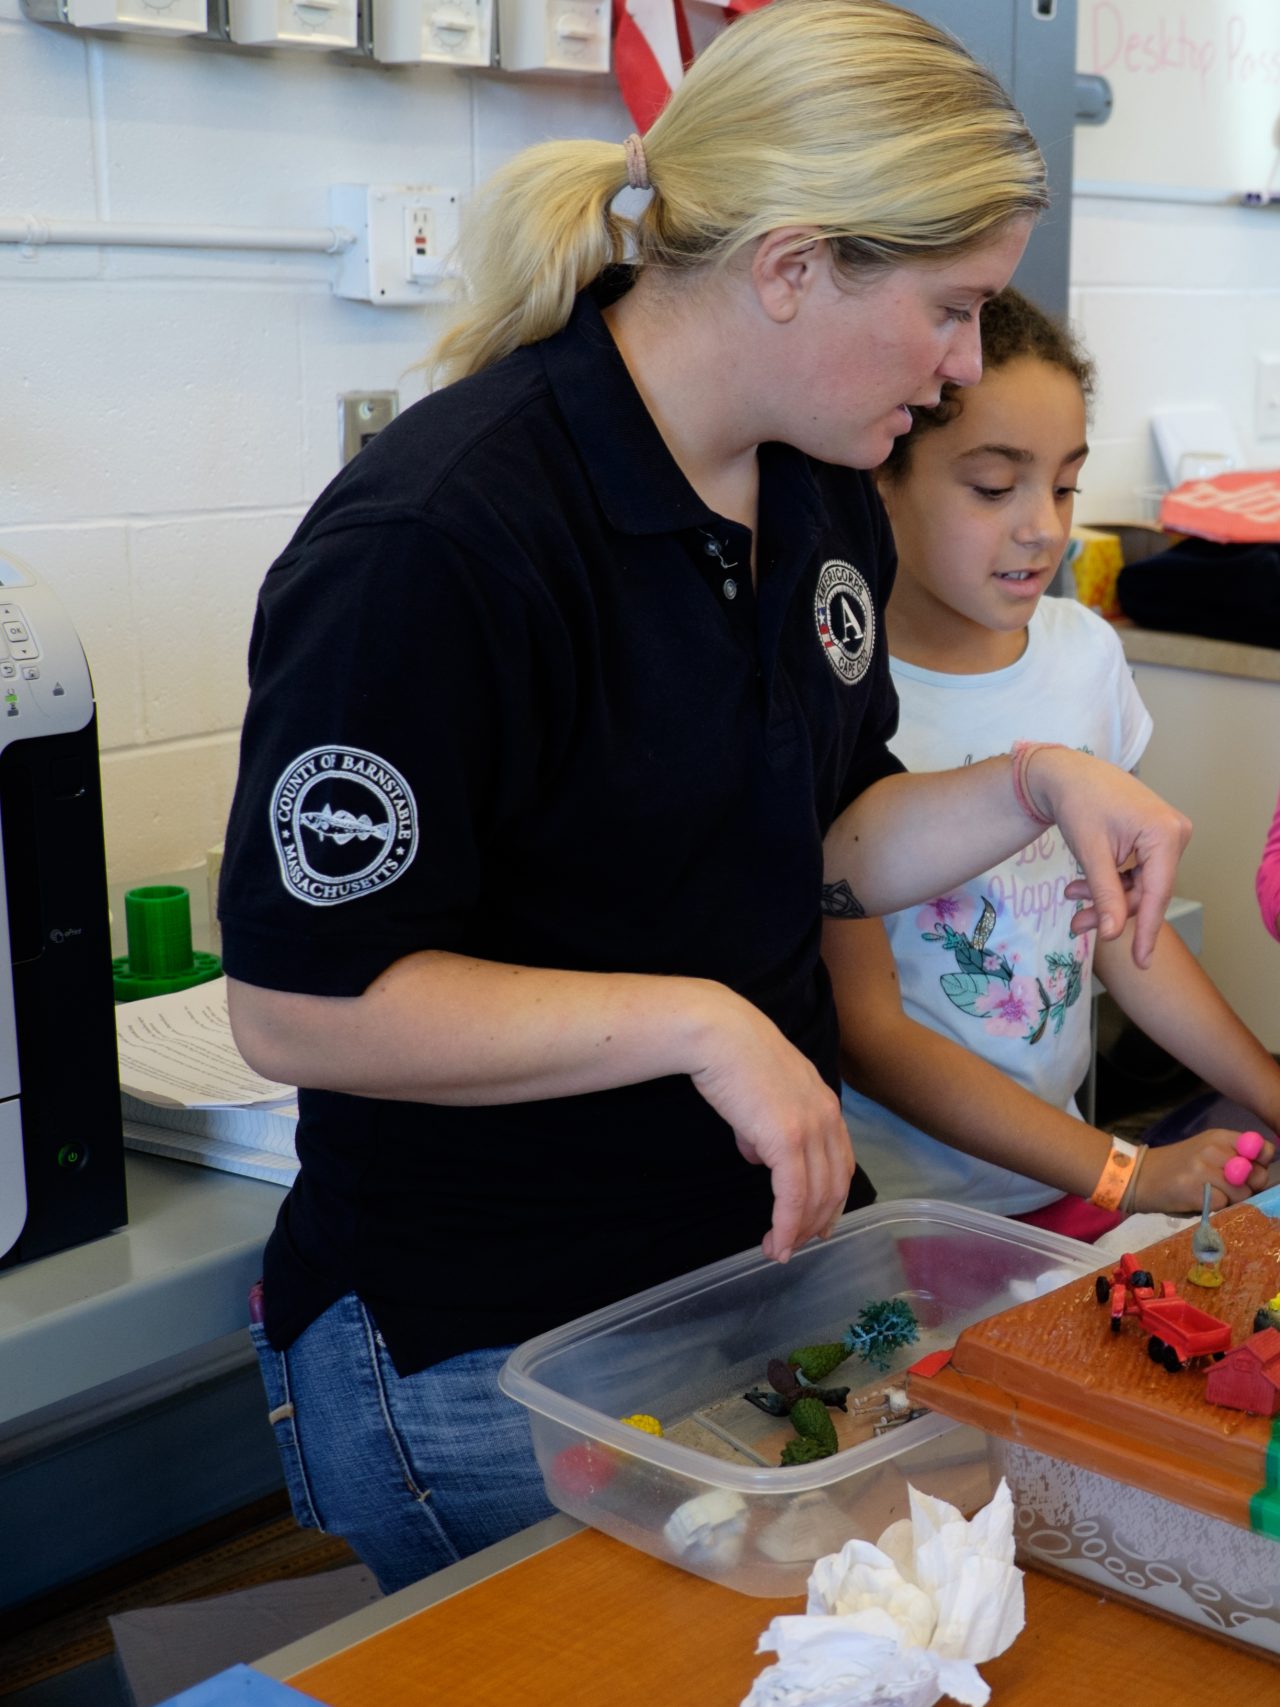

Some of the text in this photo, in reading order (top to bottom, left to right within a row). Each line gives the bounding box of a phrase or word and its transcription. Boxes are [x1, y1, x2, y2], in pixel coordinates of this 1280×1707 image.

[819, 567, 864, 604] AMERICORPS
[10, 627, 22, 635] OK
[838, 656, 856, 677] CAPE
[277, 754, 411, 840] COUNTY OF BARNSTABLE
[284, 842, 399, 899] MASSACHUSETTS
[987, 873, 1068, 933] Happ
